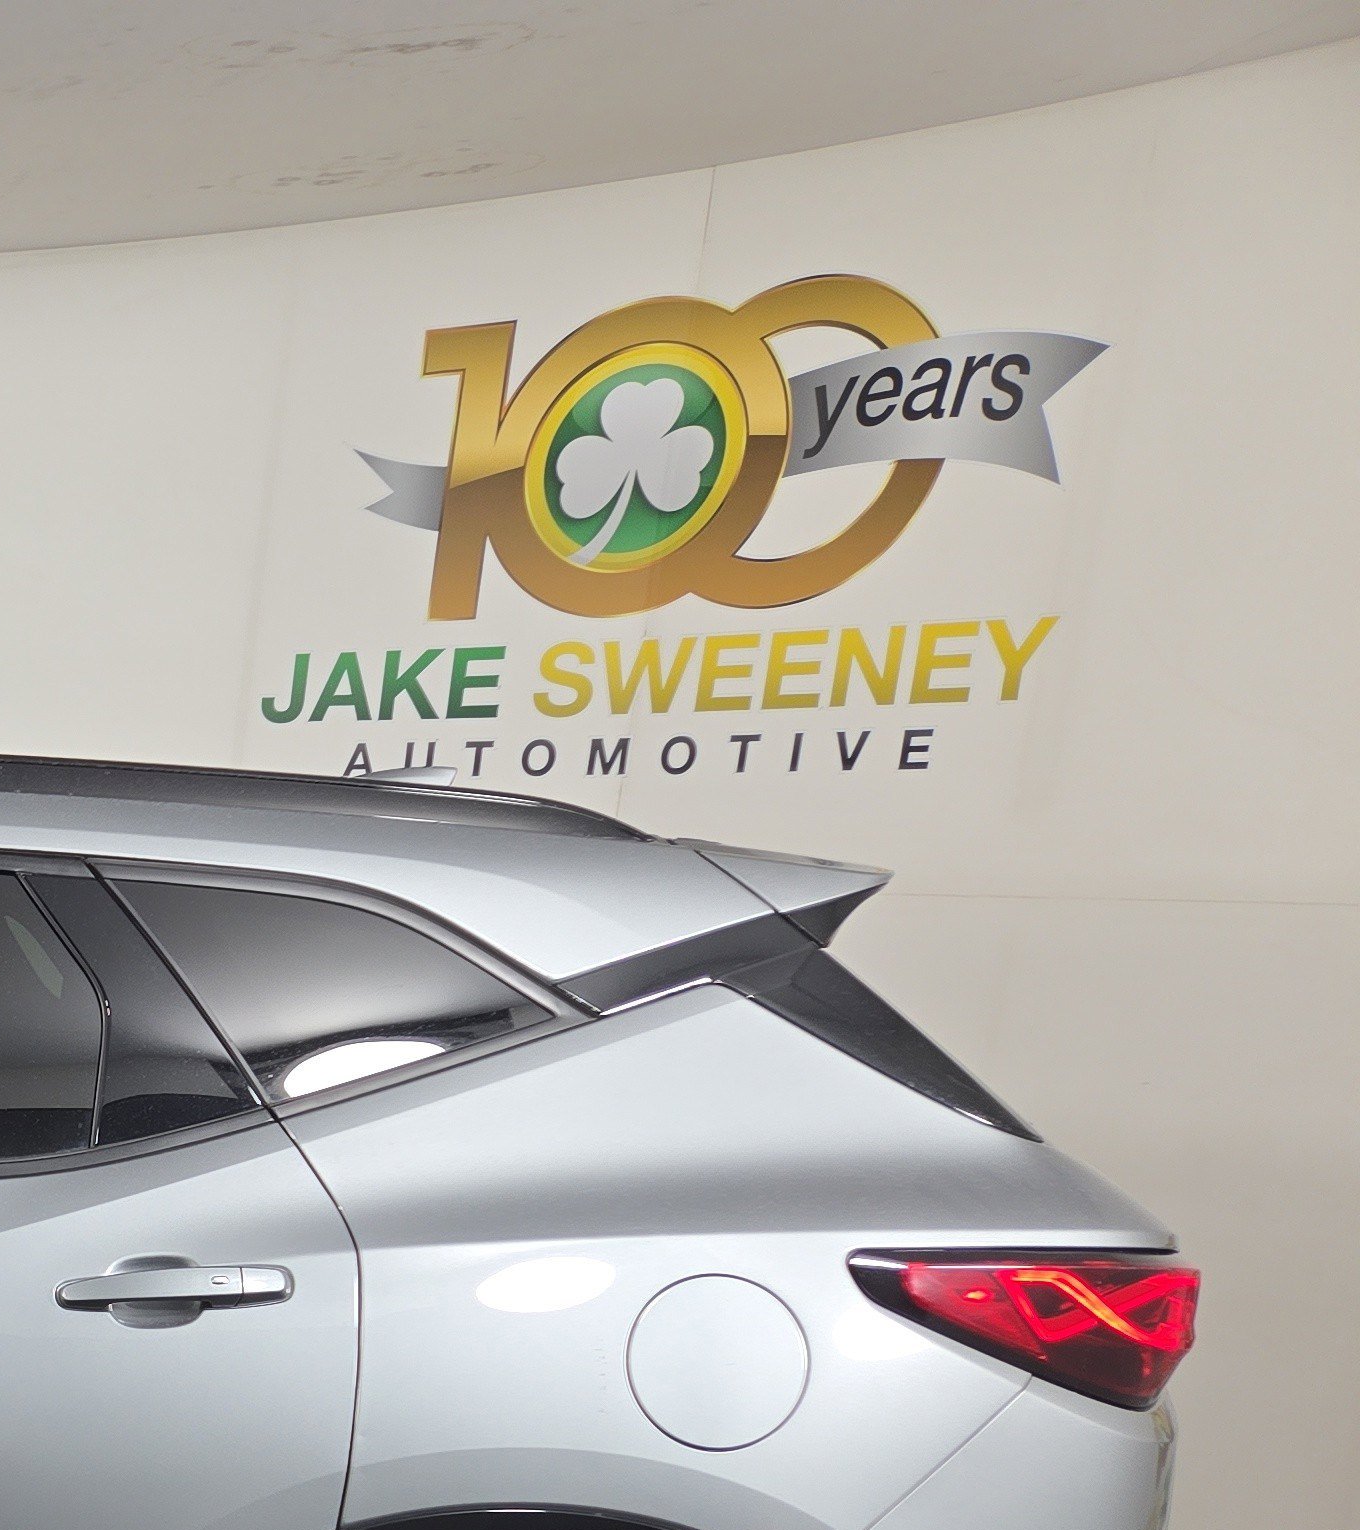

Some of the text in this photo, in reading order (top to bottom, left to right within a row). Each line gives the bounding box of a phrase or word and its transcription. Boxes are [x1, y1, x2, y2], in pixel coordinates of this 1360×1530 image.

[802, 351, 1031, 460] years
[261, 615, 1061, 724] JAKE SWEENEY
